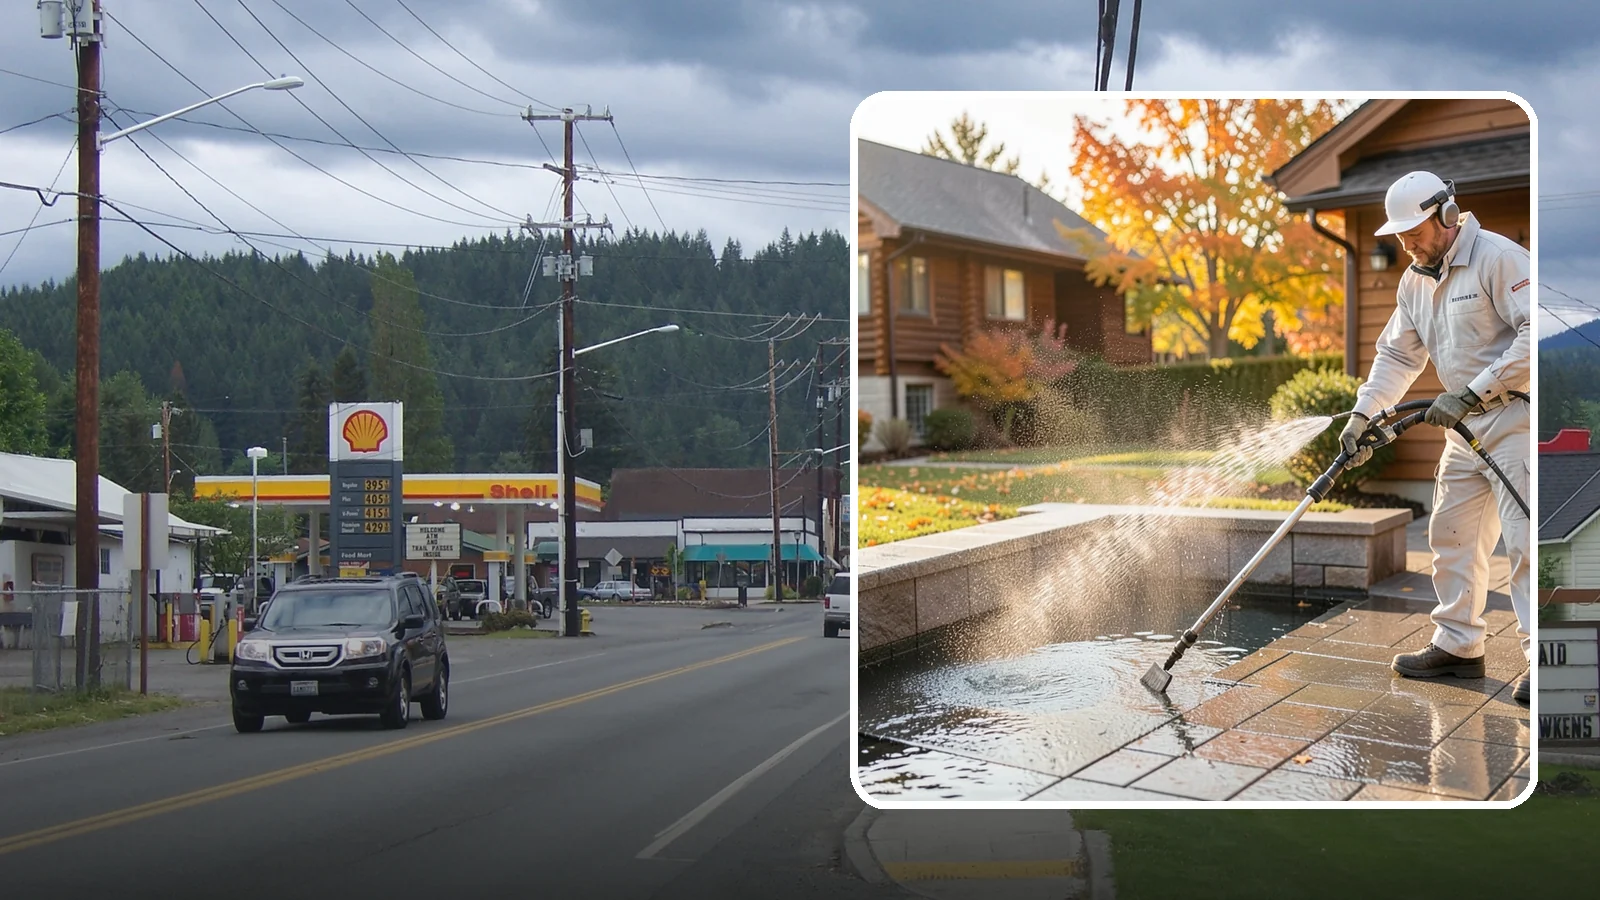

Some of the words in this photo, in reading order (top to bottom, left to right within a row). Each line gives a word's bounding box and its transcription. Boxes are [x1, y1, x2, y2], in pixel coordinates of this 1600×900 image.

[366, 480, 383, 490] 395
[490, 484, 547, 499] Shell
[365, 494, 383, 504] 405
[365, 508, 383, 518] 415
[365, 522, 383, 532] 429
